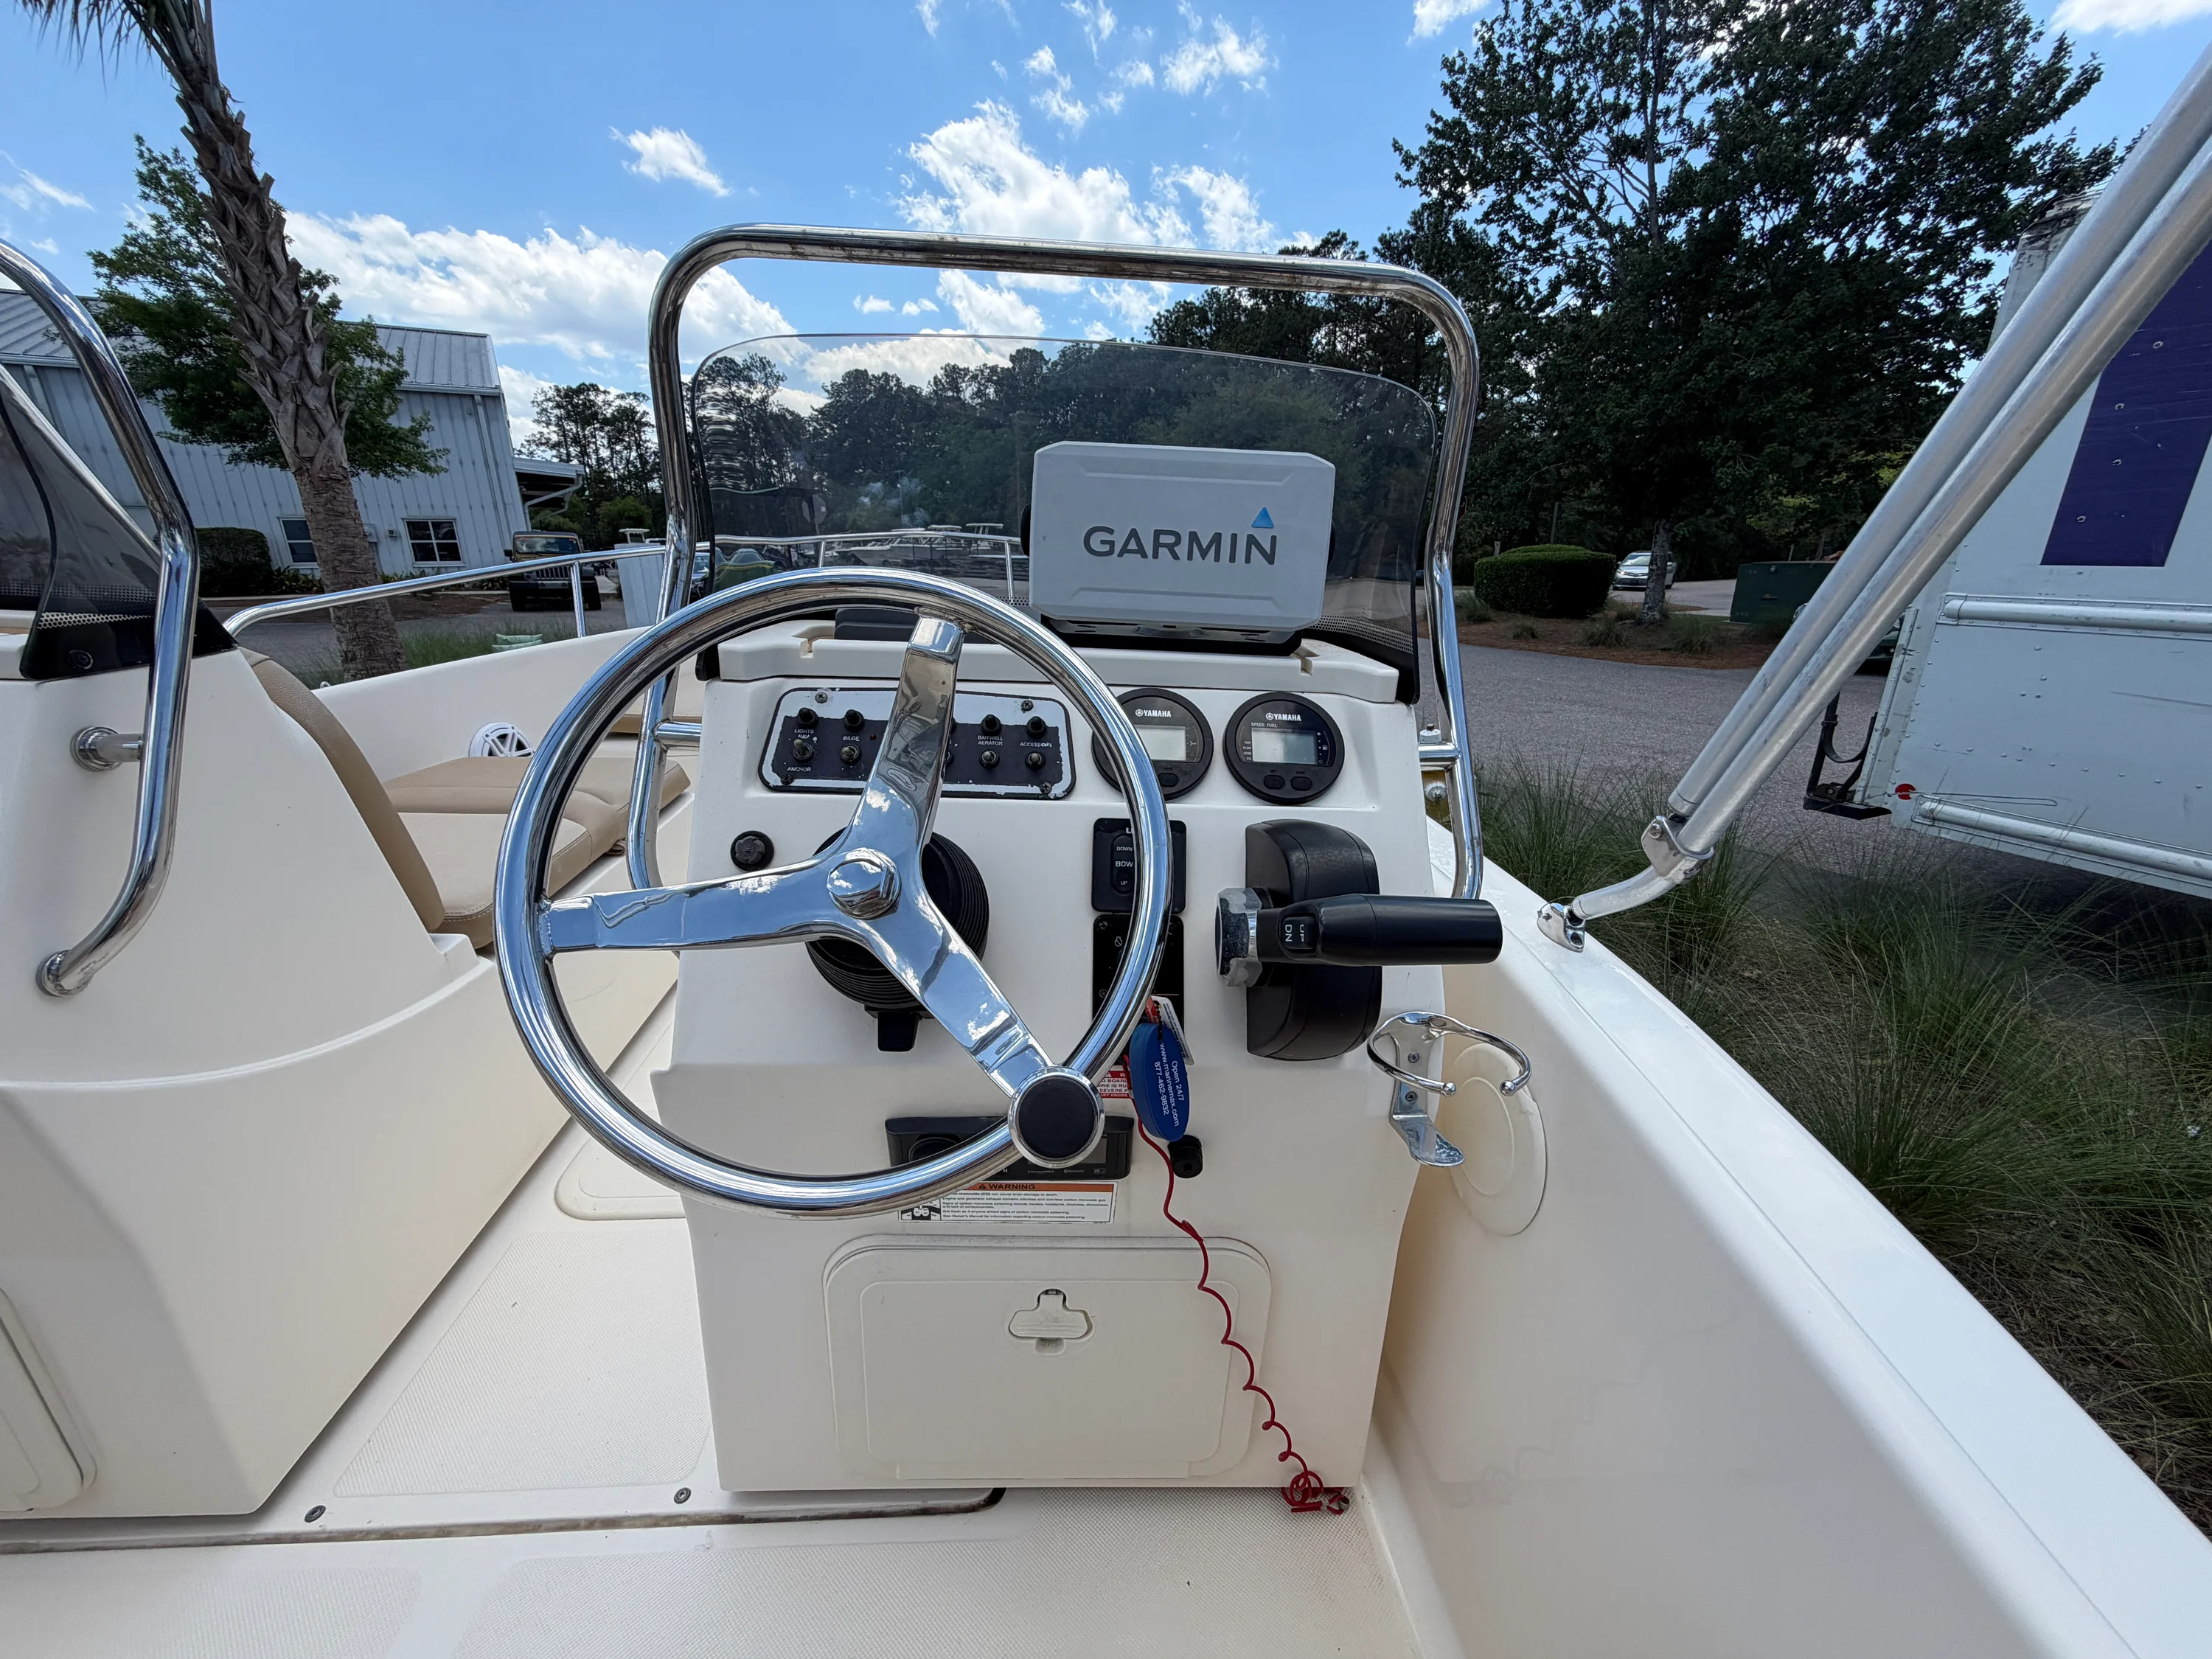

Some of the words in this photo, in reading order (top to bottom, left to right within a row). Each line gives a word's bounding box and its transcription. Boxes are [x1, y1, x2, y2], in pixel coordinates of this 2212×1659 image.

[1083, 526, 1277, 565] GARMIN
[1284, 924, 1293, 942] DN
[1299, 924, 1305, 942] UP
[1154, 1061, 1169, 1116] 877-462-9832
[1159, 1043, 1180, 1127] www.marinemax.com
[1171, 1060, 1180, 1083] Open
[1176, 1084, 1184, 1101] 24/7
